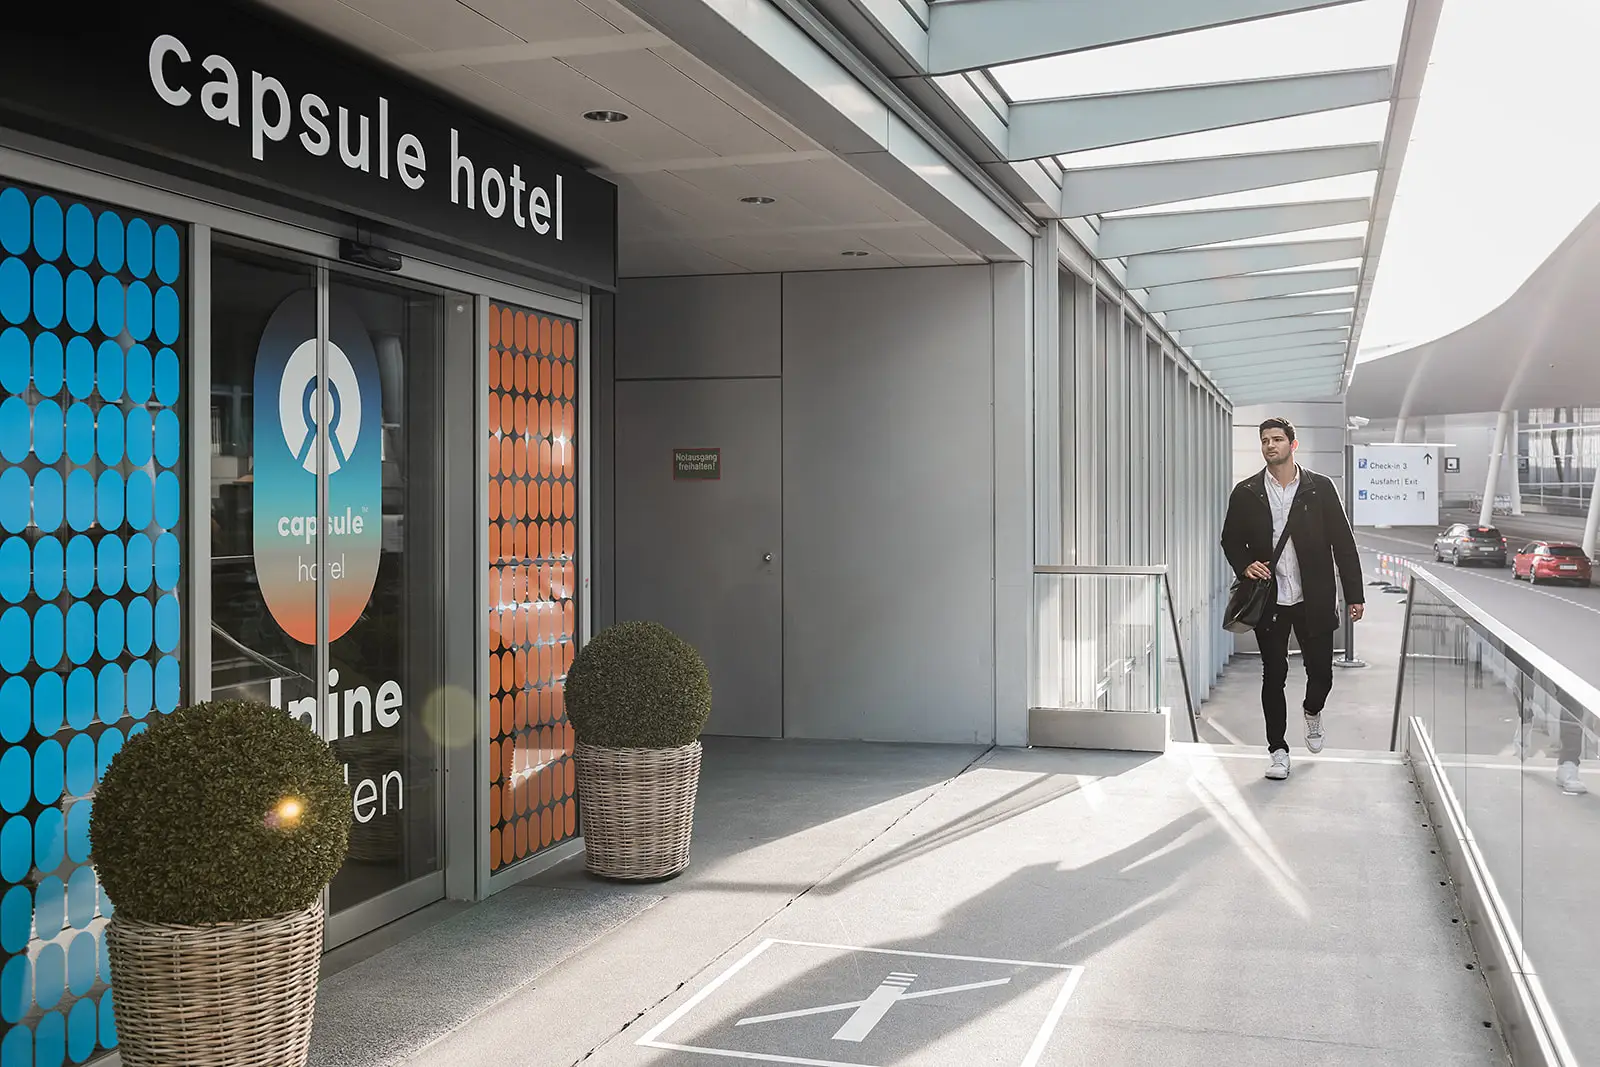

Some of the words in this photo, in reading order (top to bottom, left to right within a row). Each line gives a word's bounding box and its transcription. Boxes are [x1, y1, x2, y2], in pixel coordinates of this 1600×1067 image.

[148, 34, 426, 191] capsule
[449, 127, 564, 242] hotel
[675, 453, 718, 462] Notausgang
[678, 462, 716, 471] freihalten!
[298, 553, 345, 582] hoel
